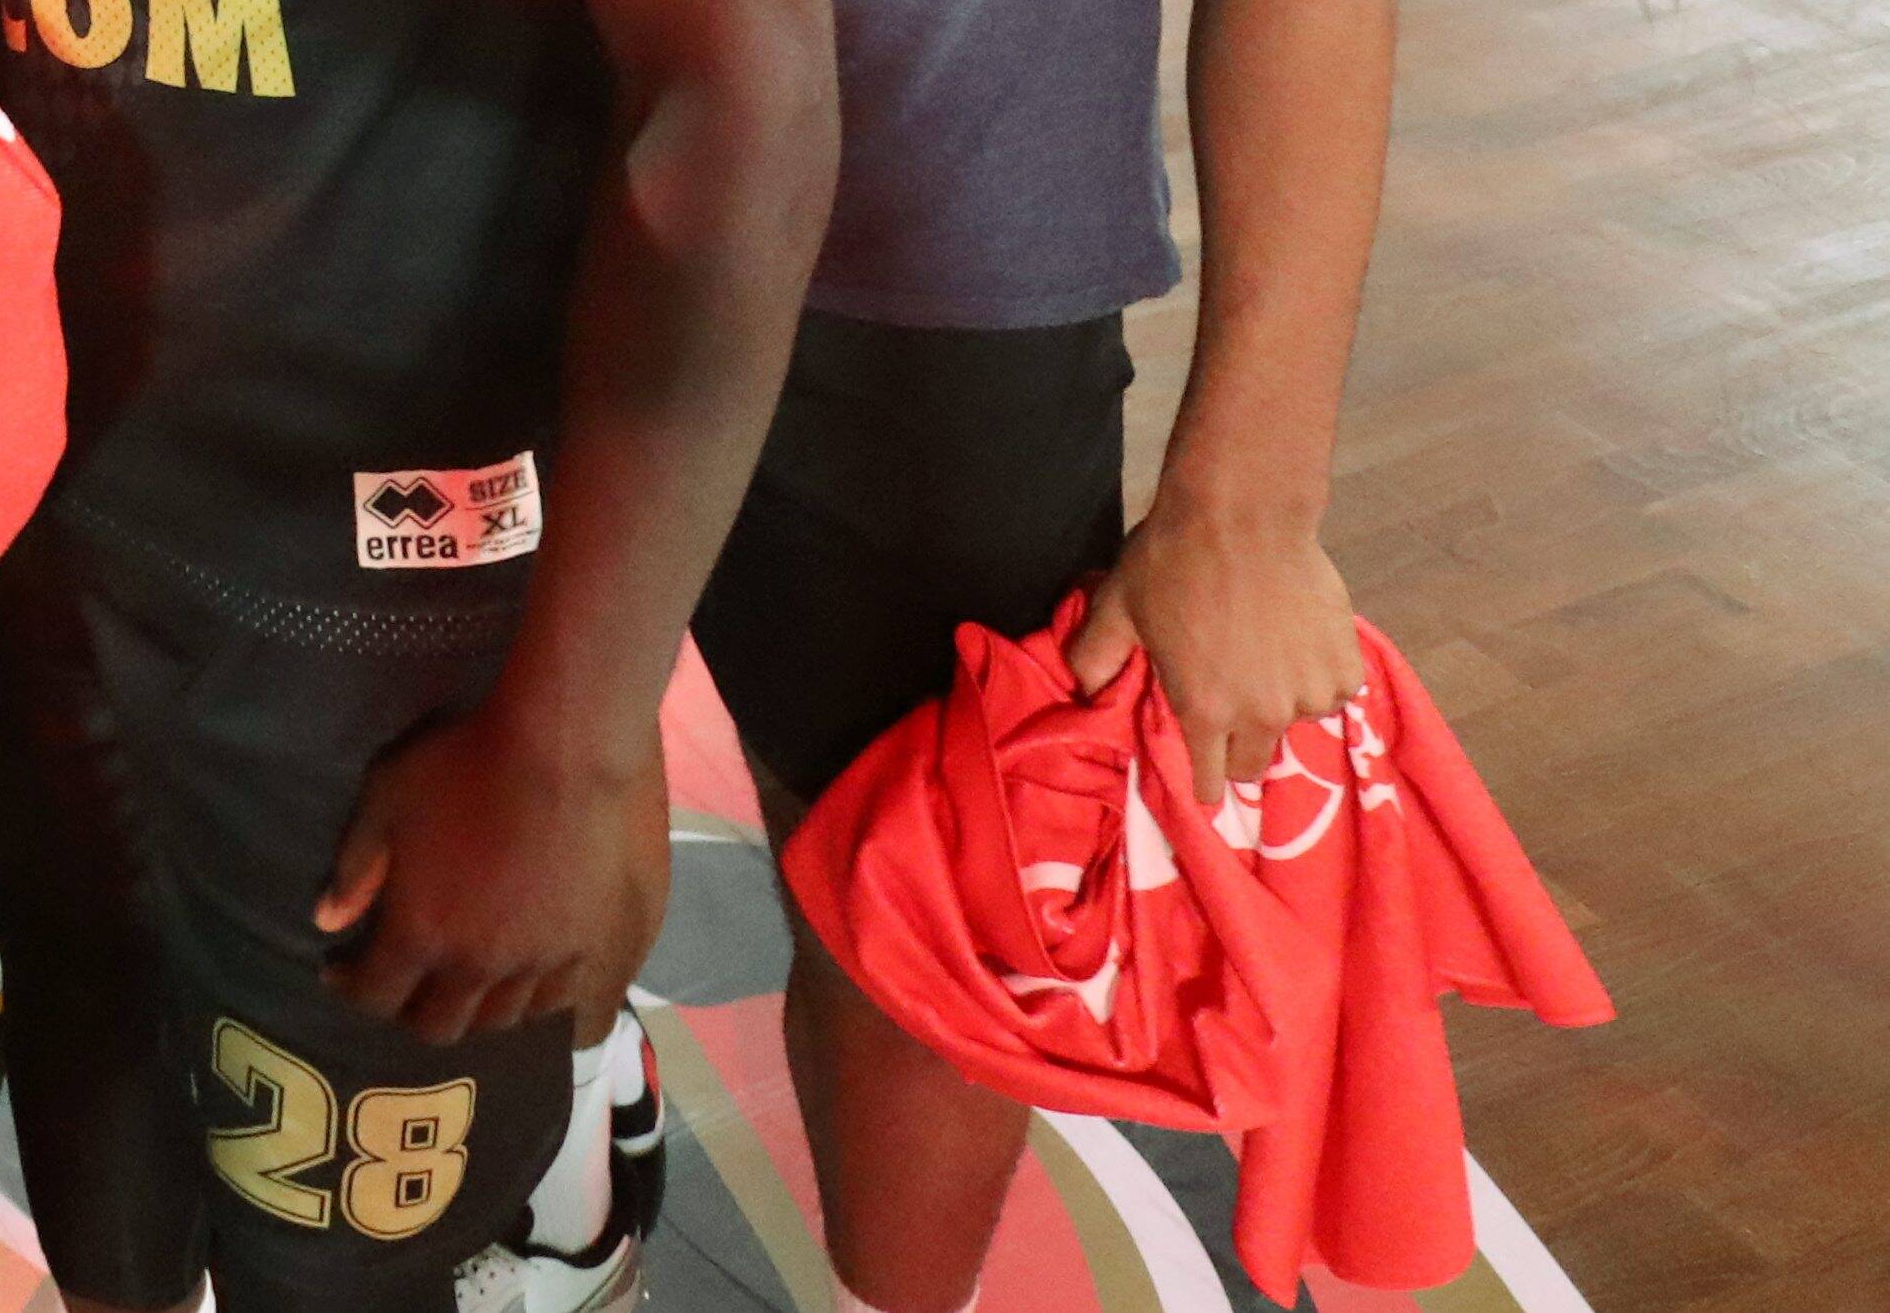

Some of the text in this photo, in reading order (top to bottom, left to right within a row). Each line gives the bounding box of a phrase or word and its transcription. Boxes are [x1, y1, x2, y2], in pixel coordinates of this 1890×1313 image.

[481, 506, 528, 537] XL
[366, 533, 459, 560] errea
[207, 1015, 477, 1240] 28
